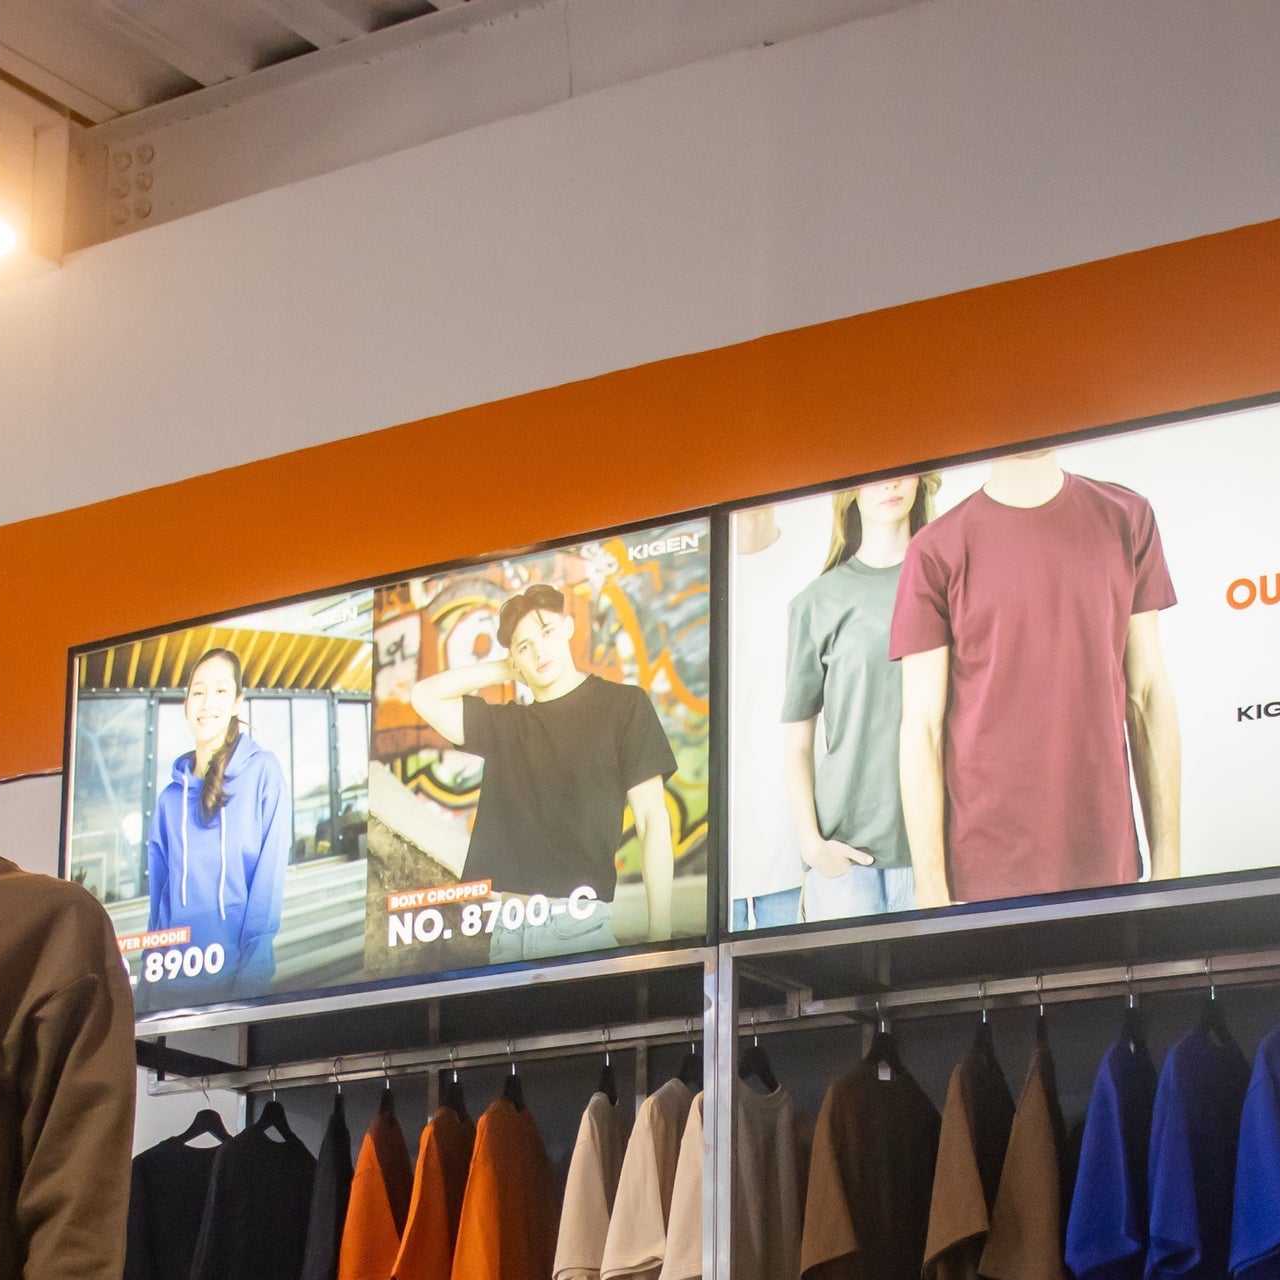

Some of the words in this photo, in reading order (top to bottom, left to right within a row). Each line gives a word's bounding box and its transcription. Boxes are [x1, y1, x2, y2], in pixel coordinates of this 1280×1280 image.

[627, 533, 699, 561] KIGEN
[390, 893, 425, 909] BOXY
[427, 883, 489, 903] CROPPED
[387, 908, 453, 947] NO.
[460, 885, 599, 937] 8700-C
[142, 930, 188, 947] HOODIE
[144, 942, 225, 983] 8900
